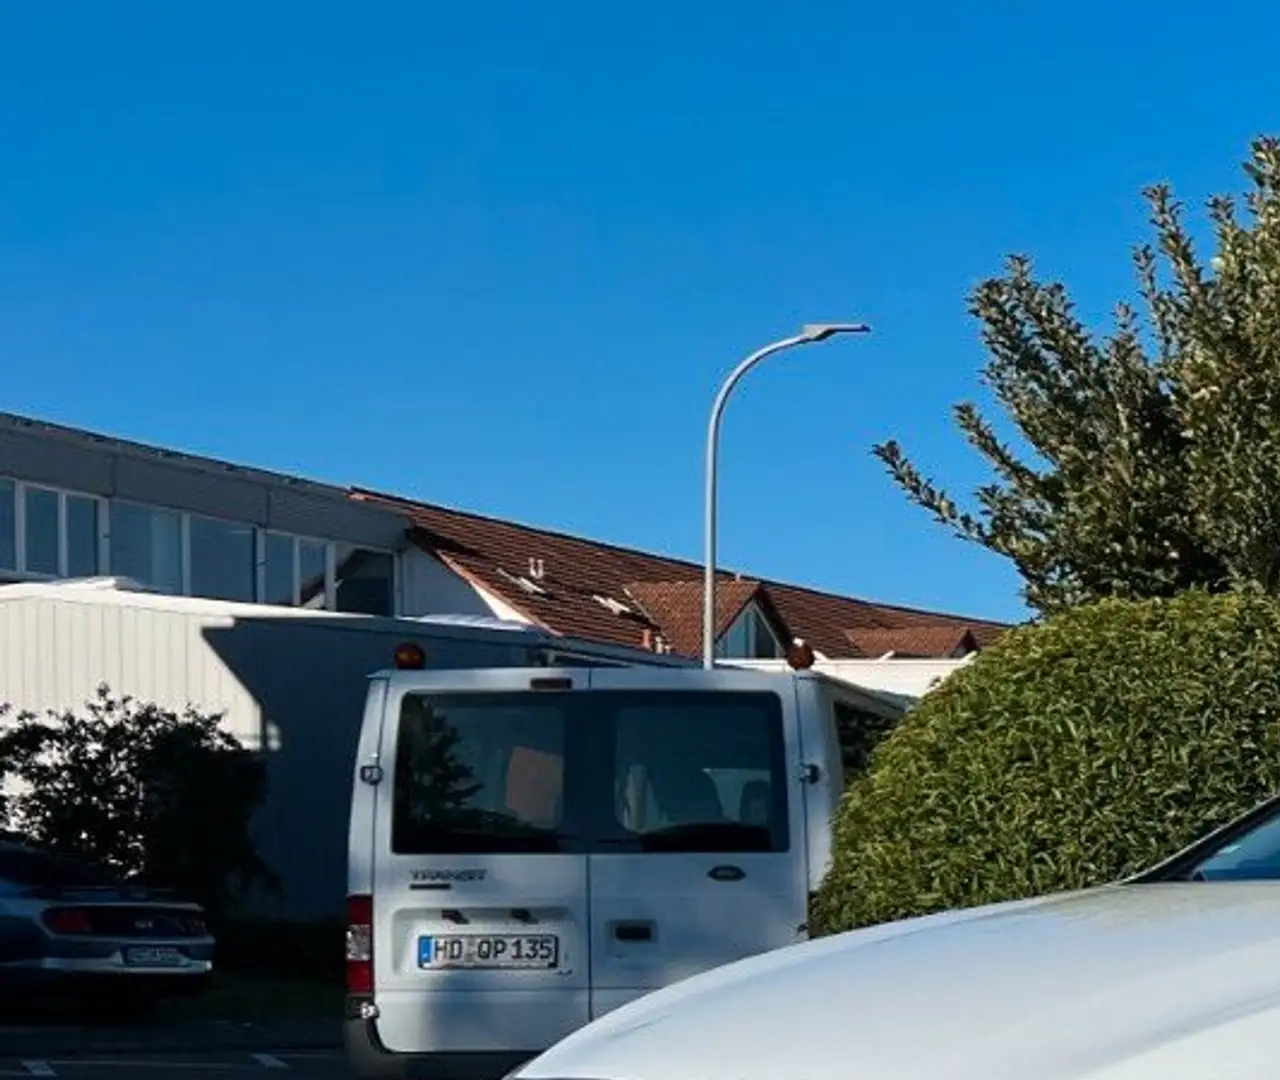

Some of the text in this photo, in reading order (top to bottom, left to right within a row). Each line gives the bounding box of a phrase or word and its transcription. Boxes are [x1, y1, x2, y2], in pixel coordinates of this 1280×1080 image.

[434, 939, 553, 960] HD QP 135
